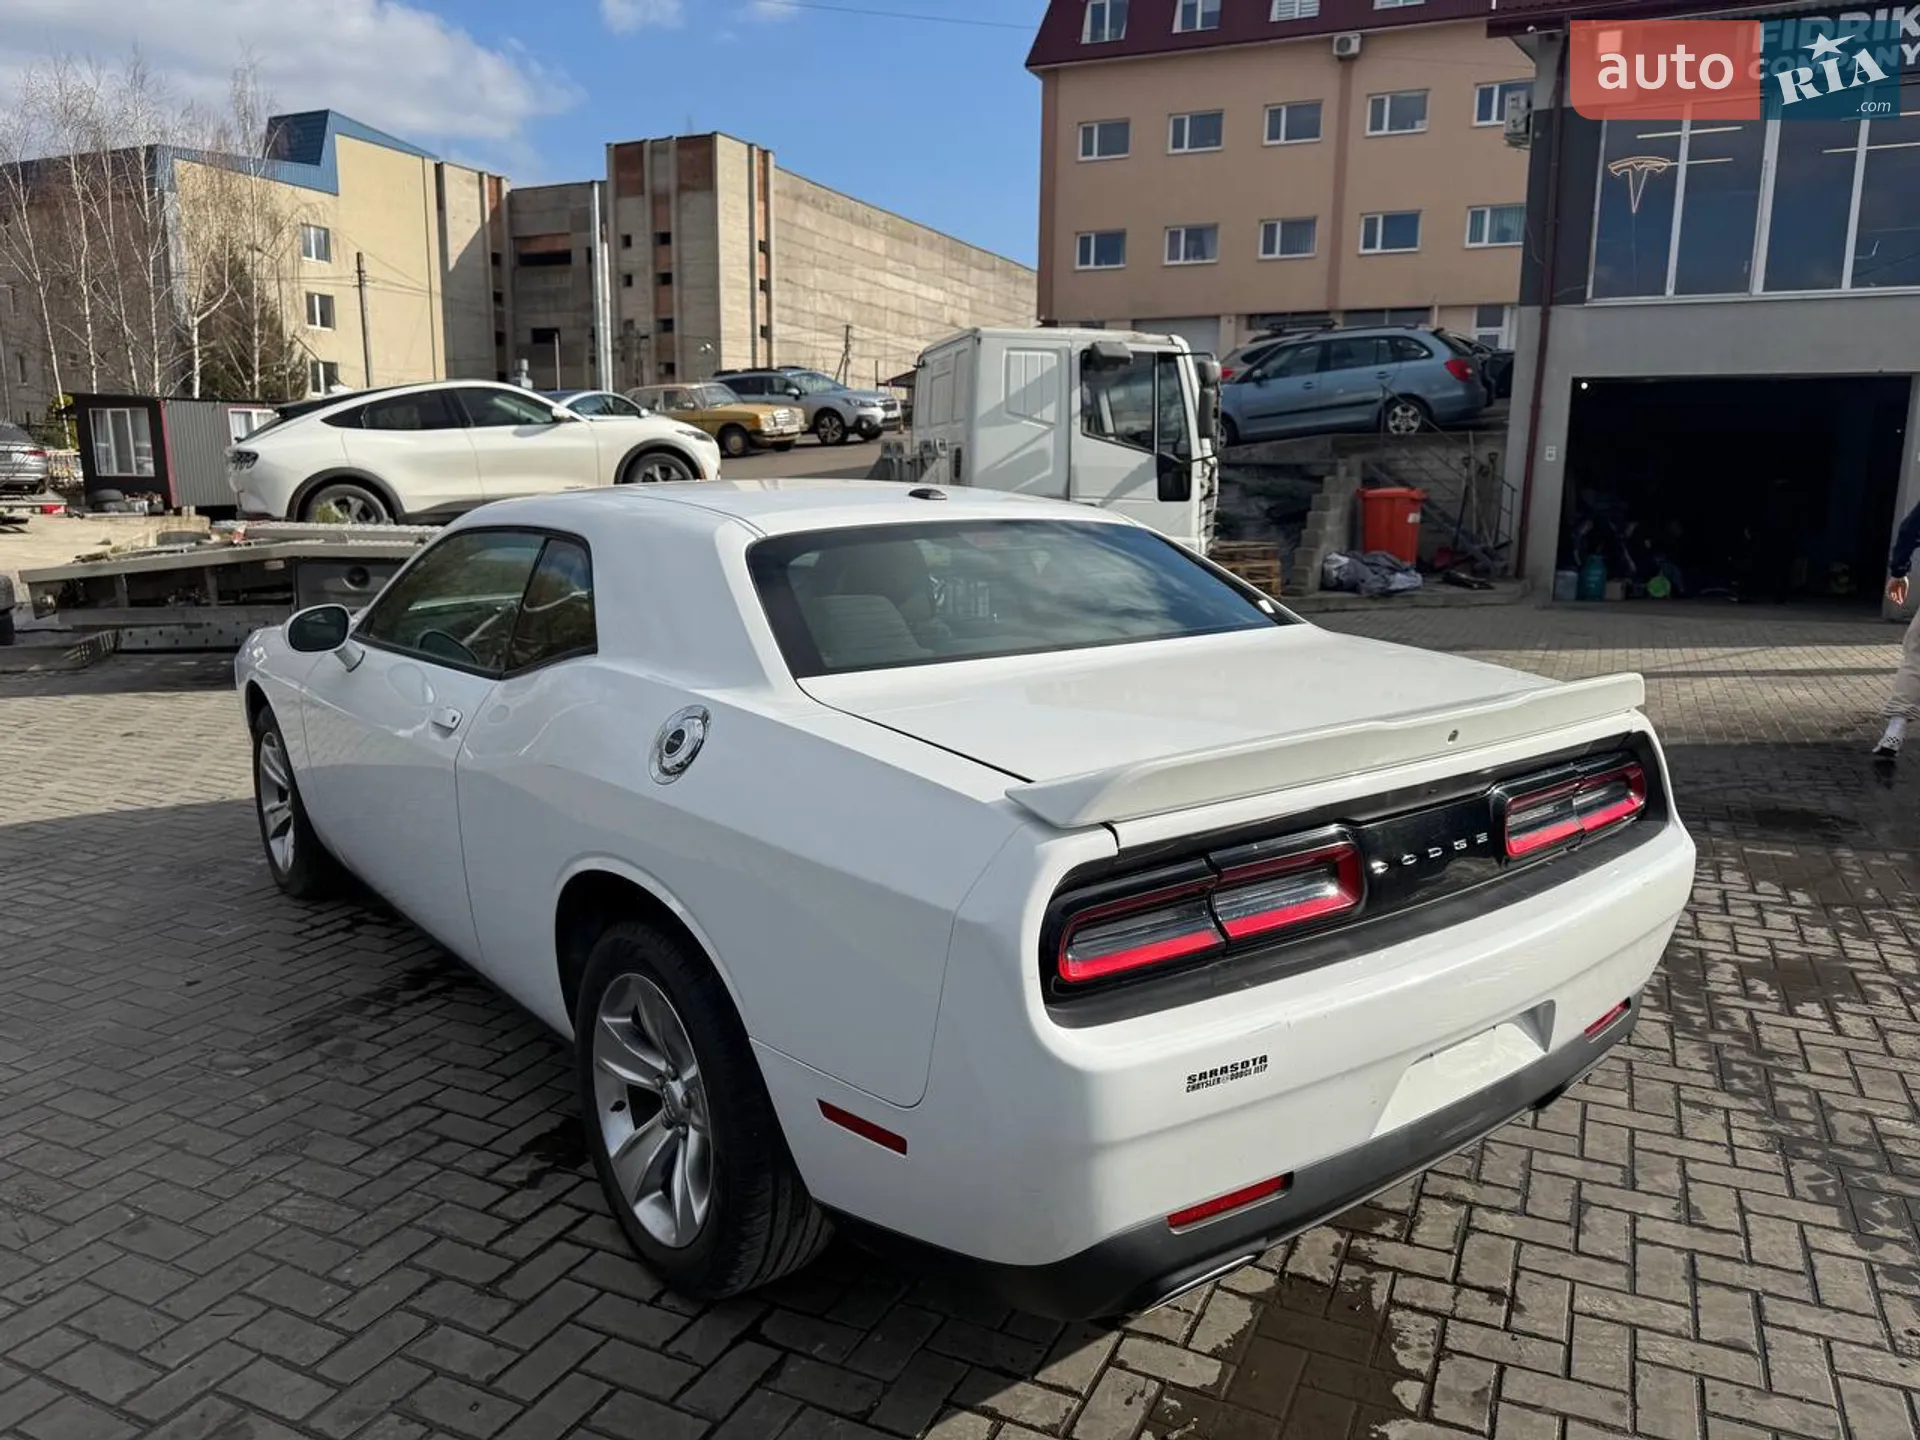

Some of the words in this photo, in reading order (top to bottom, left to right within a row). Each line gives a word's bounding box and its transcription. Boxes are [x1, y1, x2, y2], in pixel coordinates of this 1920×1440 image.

[1371, 832, 1488, 874] DODGE
[1186, 1054, 1268, 1084] SARASOTA
[1186, 1077, 1221, 1093] CHRYSLER
